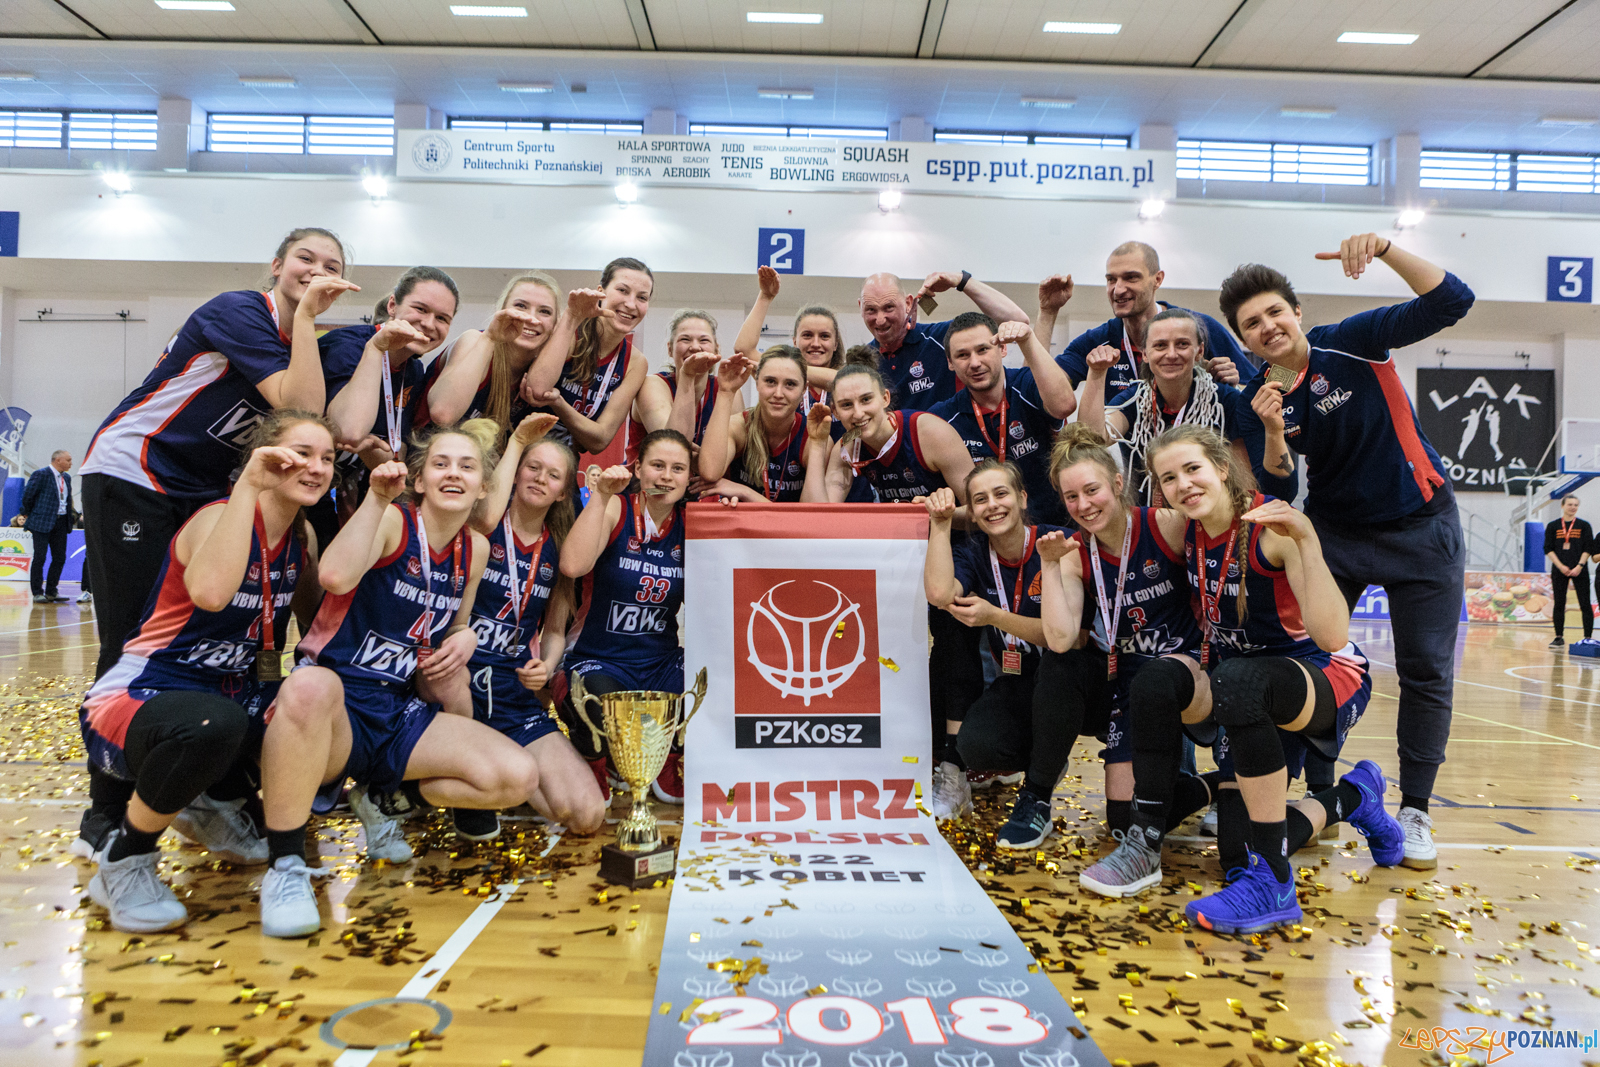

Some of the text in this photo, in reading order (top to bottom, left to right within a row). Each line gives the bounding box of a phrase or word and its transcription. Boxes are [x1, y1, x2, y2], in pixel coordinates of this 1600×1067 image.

[464, 139, 555, 155] Centrum Sportu
[618, 141, 711, 152] HALA SPORTOWA
[721, 143, 745, 153] JUDO
[843, 147, 909, 163] SQUASH
[463, 157, 603, 175] Politechniki Poznańskiej
[721, 156, 763, 169] TENIS
[784, 156, 829, 166] SIŁOWNIA
[616, 167, 652, 177] BOISKA
[663, 168, 711, 178] AEROBIK
[770, 167, 834, 182] BOWLING
[842, 172, 910, 183] ERGOWIOSŁA
[926, 157, 1155, 189] cspp.put.poznan.pl
[769, 232, 793, 269] 2
[1558, 260, 1583, 298] 3
[909, 378, 928, 393] VBW
[1316, 391, 1342, 413] VBW
[1428, 376, 1542, 420] LAK
[1012, 439, 1033, 458] VBW
[898, 485, 929, 498] GDYNIA
[482, 567, 501, 584] BW
[618, 556, 642, 572] VBW
[642, 561, 660, 576] GTK
[393, 579, 420, 602] VBW
[635, 575, 671, 604] 33
[1134, 579, 1175, 603] GDYNIA
[231, 591, 259, 609] VBW
[495, 590, 522, 621] 7
[406, 610, 436, 644] 4
[612, 604, 661, 632] VBW
[1127, 606, 1148, 633] 3
[359, 636, 418, 679] VBW
[755, 720, 863, 744] PZKOSZ
[702, 779, 919, 825] MISTRZ
[700, 830, 931, 846] POLSKI
[728, 869, 927, 883] KOBIET
[686, 995, 1049, 1046] 2018
